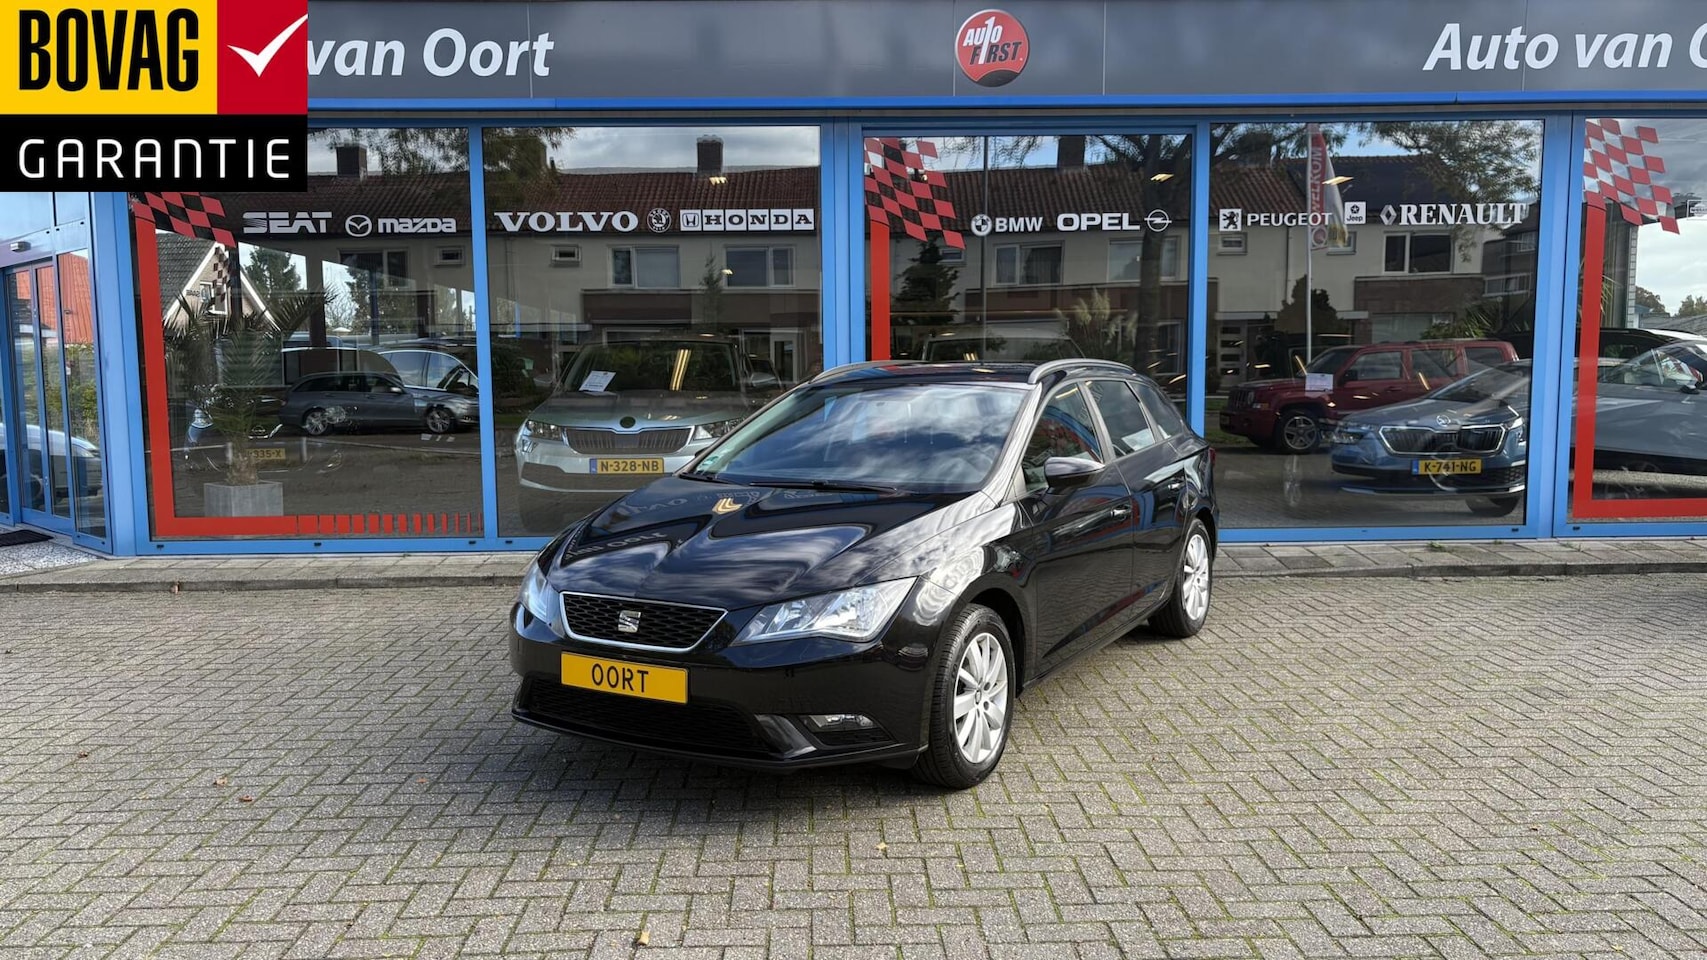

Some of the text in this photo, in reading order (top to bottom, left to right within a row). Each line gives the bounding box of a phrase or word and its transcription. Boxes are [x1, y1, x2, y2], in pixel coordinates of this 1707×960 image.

[308, 27, 555, 77] van Oort
[1422, 23, 1559, 71] Auto
[1575, 33, 1673, 69] van
[243, 211, 332, 234] SEAT
[494, 211, 639, 232] VOLVO
[704, 214, 812, 225] HONDA
[995, 216, 1043, 232] BMW
[1056, 213, 1141, 231] OPEL
[1247, 212, 1332, 227] PEUGEOT
[1399, 203, 1527, 226] RENAULT
[600, 461, 659, 472] N-328-NB
[1424, 461, 1477, 473] K-741-NG
[591, 663, 650, 693] OORT
